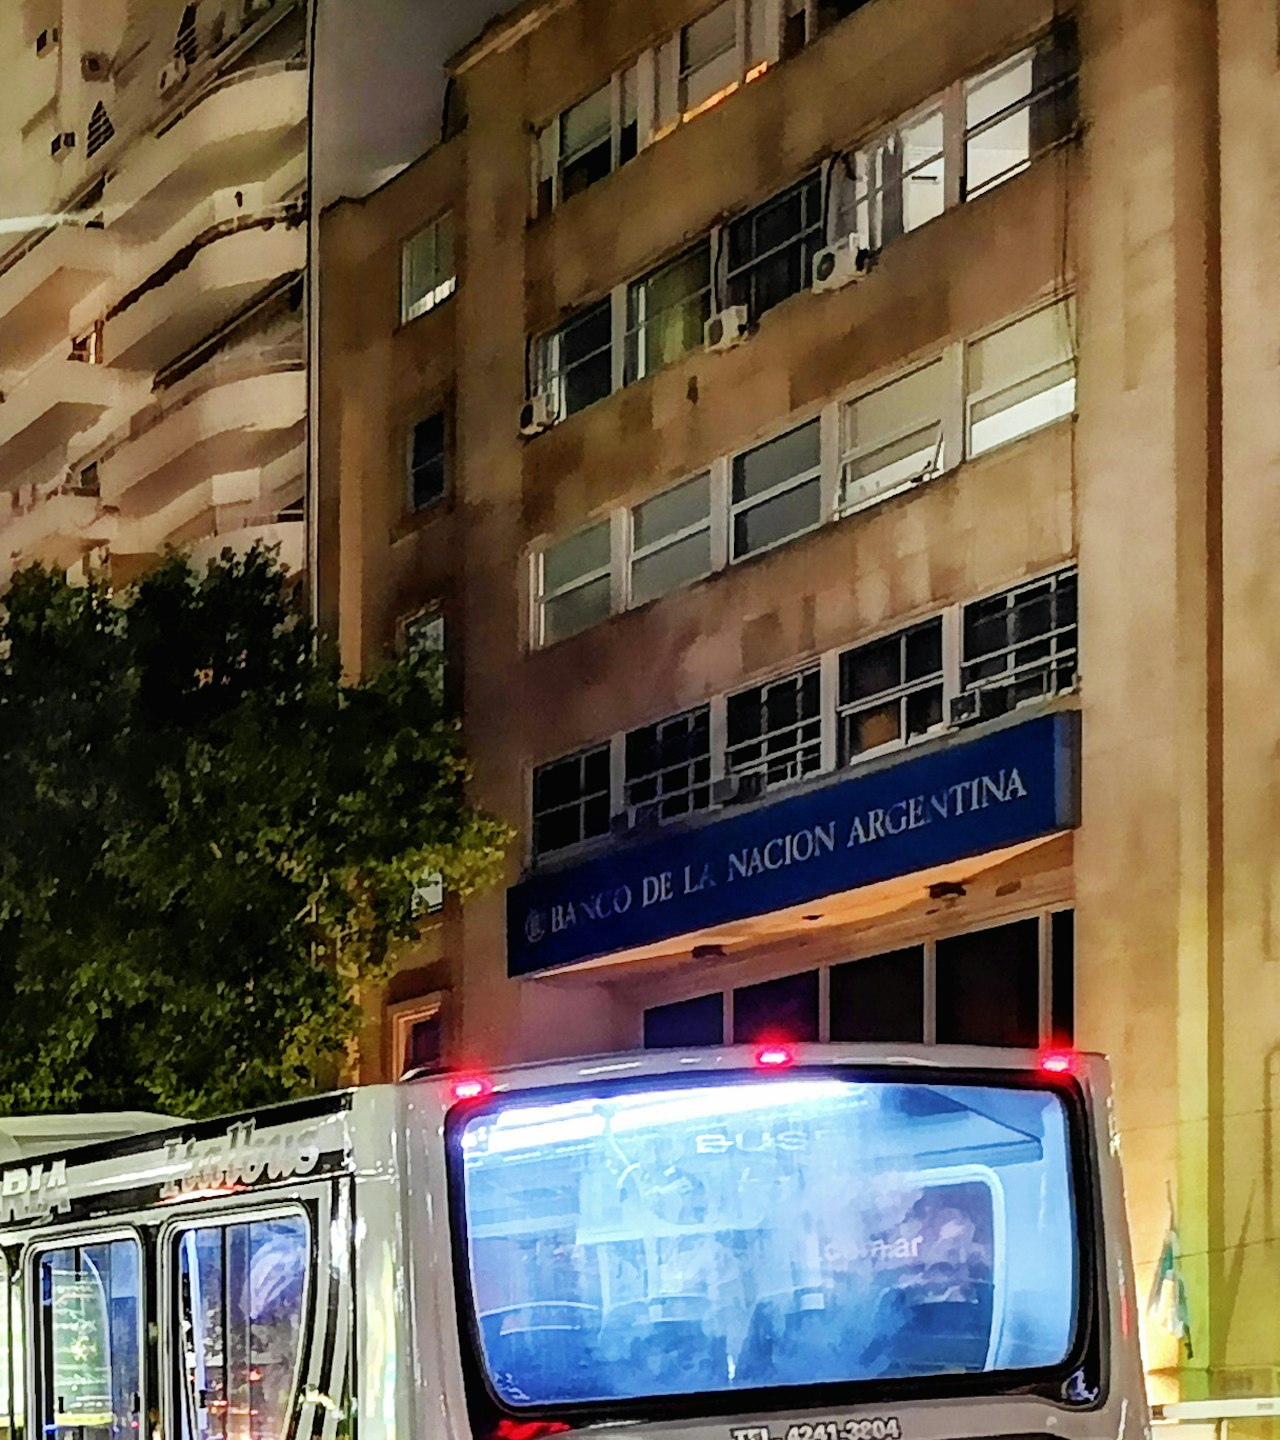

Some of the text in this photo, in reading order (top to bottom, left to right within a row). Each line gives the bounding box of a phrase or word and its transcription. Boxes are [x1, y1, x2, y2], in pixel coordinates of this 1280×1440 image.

[551, 768, 1028, 932] BANCO DE LA NACION ARGENTINA
